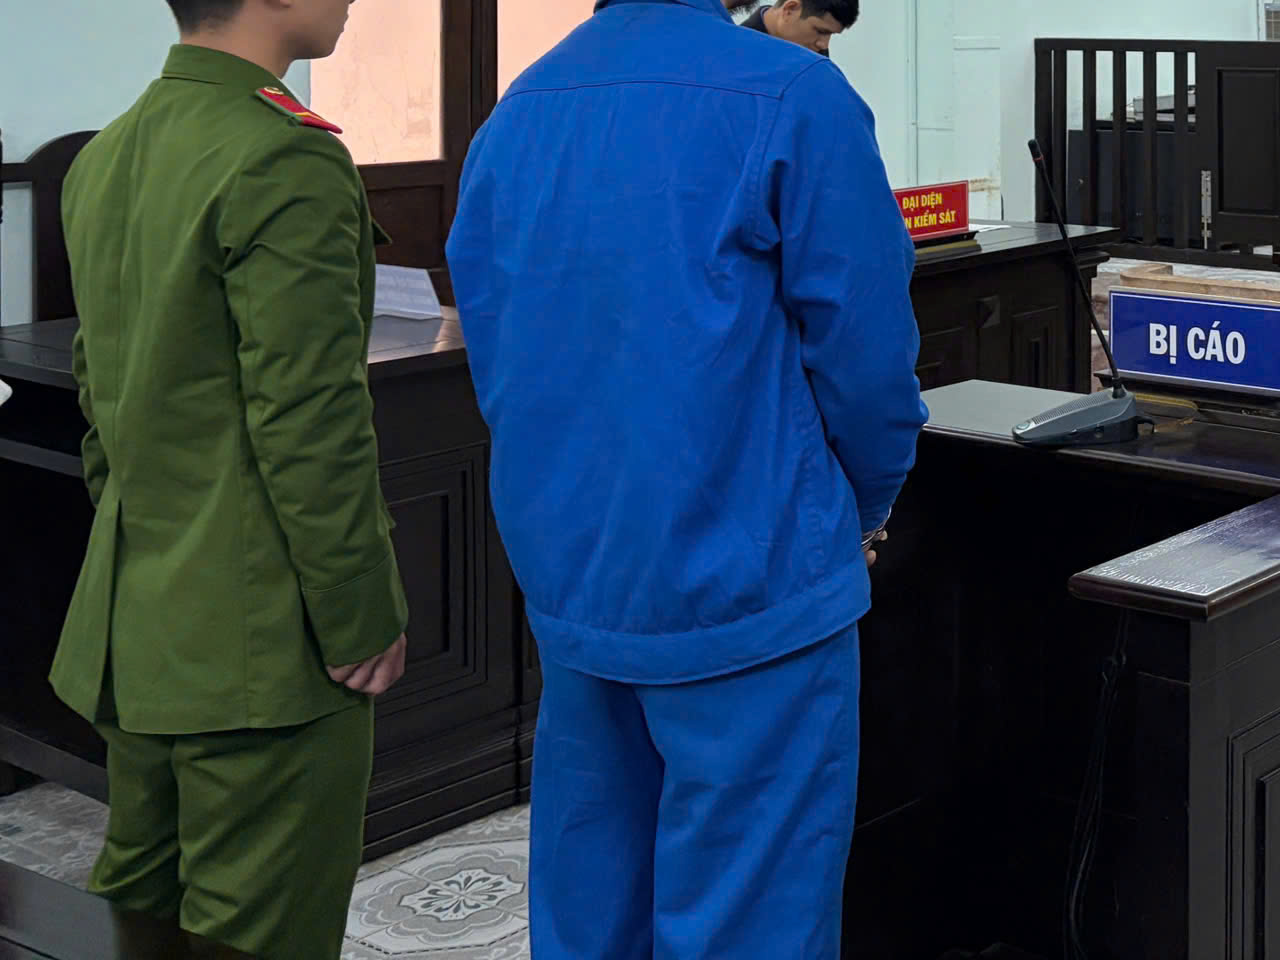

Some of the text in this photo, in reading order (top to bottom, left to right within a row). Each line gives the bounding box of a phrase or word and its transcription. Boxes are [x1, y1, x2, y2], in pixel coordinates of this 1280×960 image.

[921, 191, 943, 209] DIỆN
[913, 209, 937, 228] KIỂM
[939, 208, 956, 224] SÁT
[1149, 320, 1246, 364] BỊ CÁO
